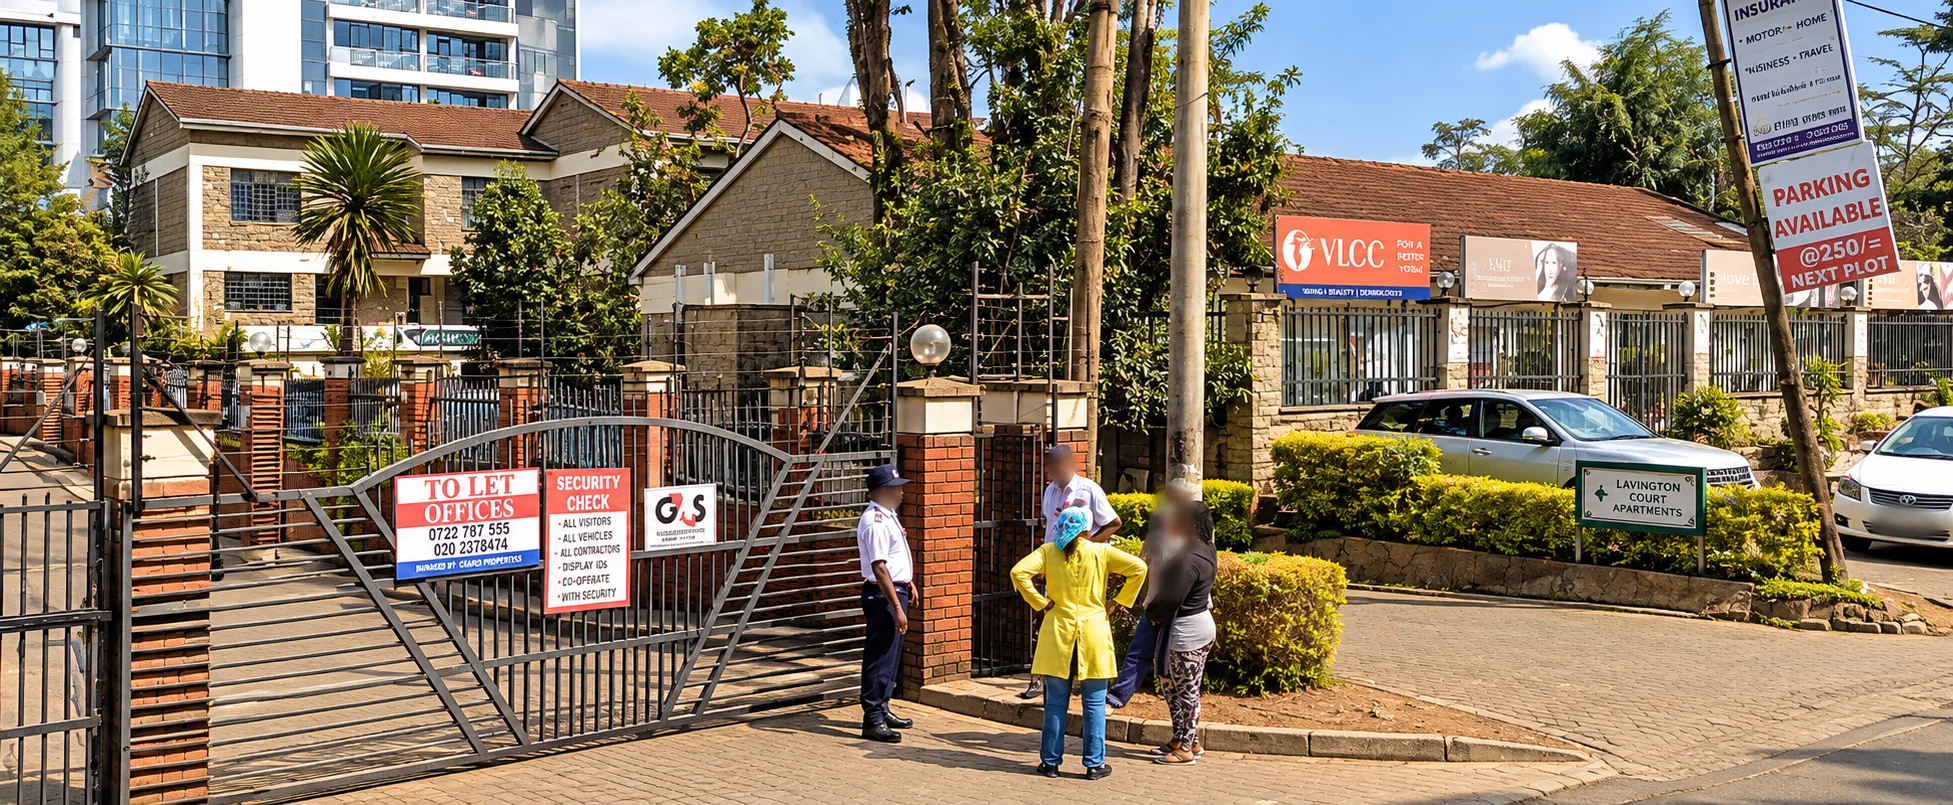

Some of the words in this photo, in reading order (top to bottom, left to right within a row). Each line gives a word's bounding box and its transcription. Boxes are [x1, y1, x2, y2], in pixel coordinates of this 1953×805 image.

[1734, 0, 1800, 21] INSURA
[1746, 26, 1782, 44] MOTOR
[1796, 12, 1827, 30] HOME
[1773, 168, 1870, 207] PARKING
[1775, 197, 1883, 239] AVAILABLE
[1320, 238, 1385, 269] VLCC
[1800, 235, 1881, 268] @250/=
[1791, 266, 1838, 288] NEXT
[1843, 255, 1889, 278] PLOT
[424, 478, 460, 500] TO
[468, 474, 514, 497] LET
[556, 475, 621, 491] SECURITY
[1616, 479, 1681, 492] LAVINGTON
[567, 494, 610, 511] CHECK
[1629, 493, 1667, 504] COURT
[424, 498, 515, 524] OFFICES
[1613, 504, 1683, 517] APARTMENTS
[429, 526, 458, 541] 0722
[462, 524, 484, 538] 787
[488, 522, 510, 536] 555
[563, 519, 577, 528] ALL
[579, 516, 612, 527] VISITORS
[434, 542, 455, 556] 020
[460, 537, 508, 554] 2378474
[563, 533, 576, 543] ALL
[578, 531, 613, 542] VEHICLES
[560, 548, 572, 557] ALL
[574, 544, 621, 557] CONTRACTORS
[563, 561, 593, 572] DISPLAY
[562, 591, 580, 602] WITH
[582, 588, 617, 600] SECURITY
